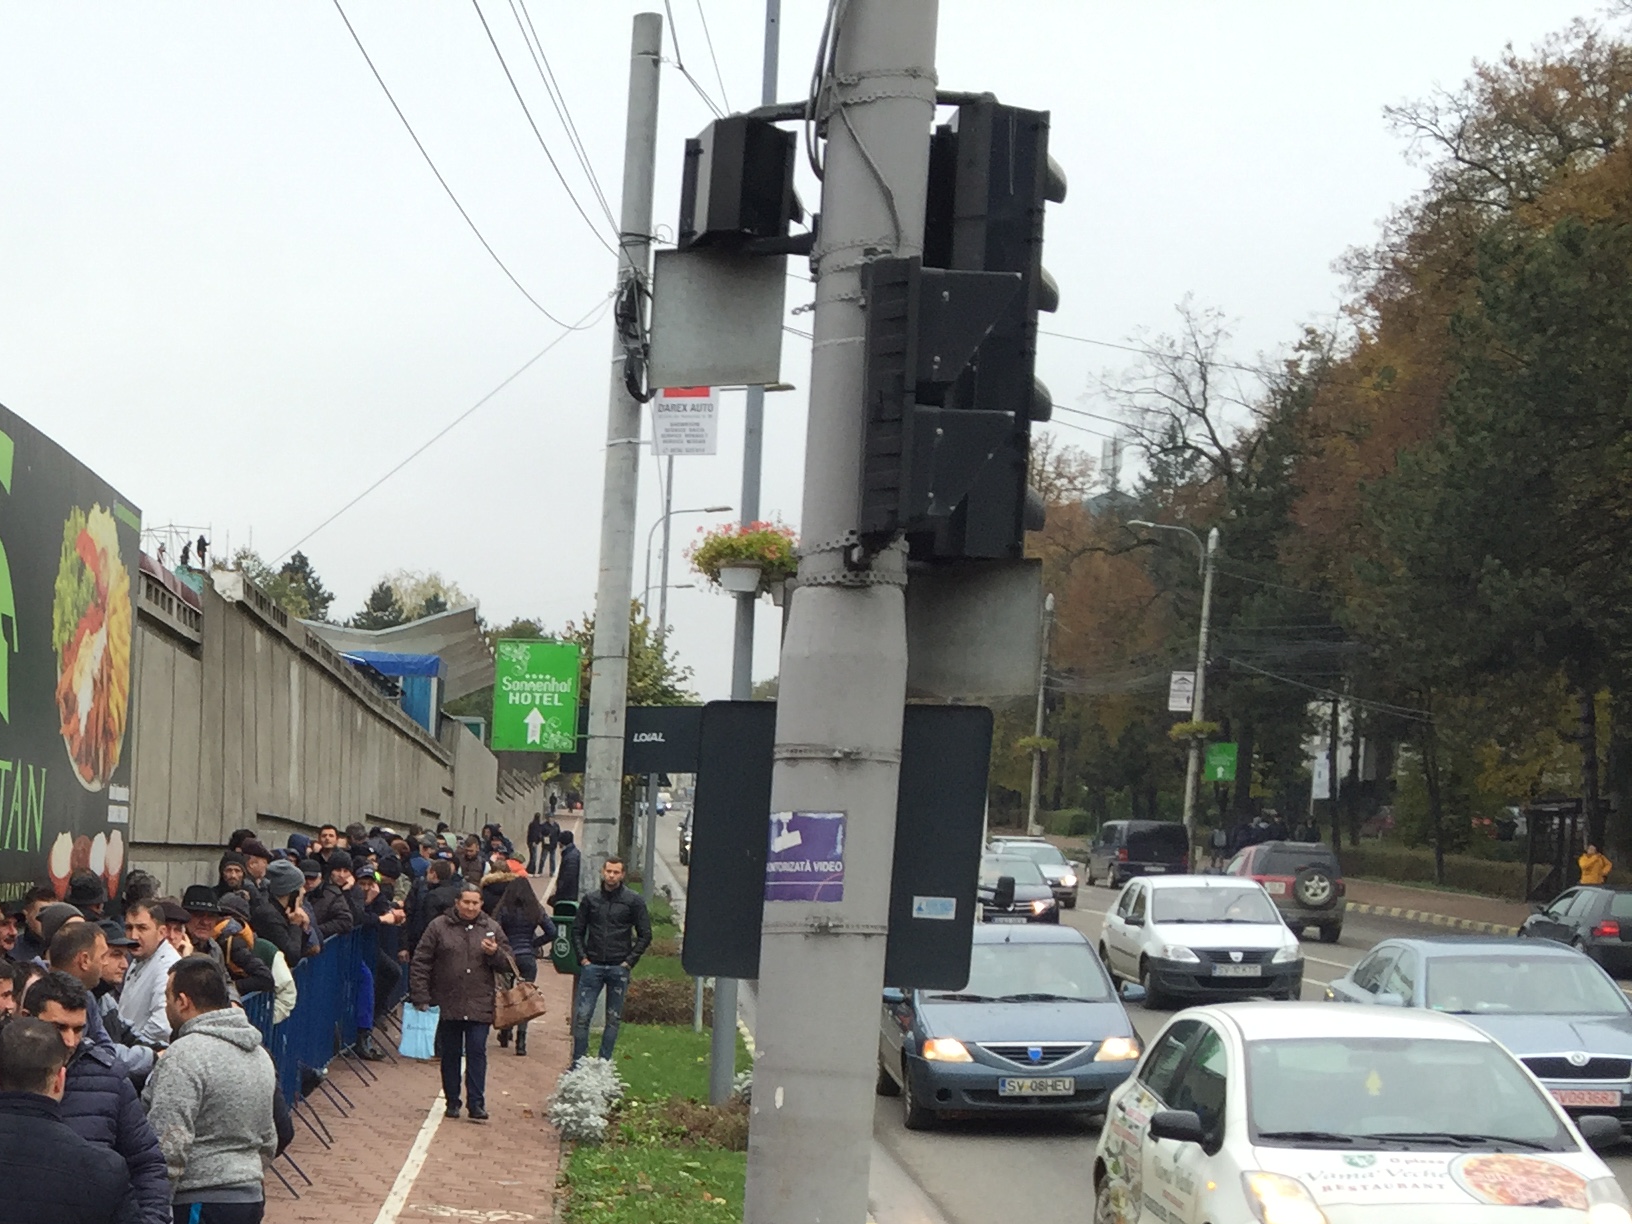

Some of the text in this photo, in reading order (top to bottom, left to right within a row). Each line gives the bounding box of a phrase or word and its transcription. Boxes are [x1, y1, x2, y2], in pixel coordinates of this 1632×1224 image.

[658, 403, 714, 412] DAREX AUTO
[502, 676, 572, 692] Sonnenhof
[508, 692, 564, 706] HOTEL
[813, 861, 843, 873] VIDEO
[1007, 1080, 1025, 1092] SV
[1322, 1182, 1446, 1193] RESTAURANT
